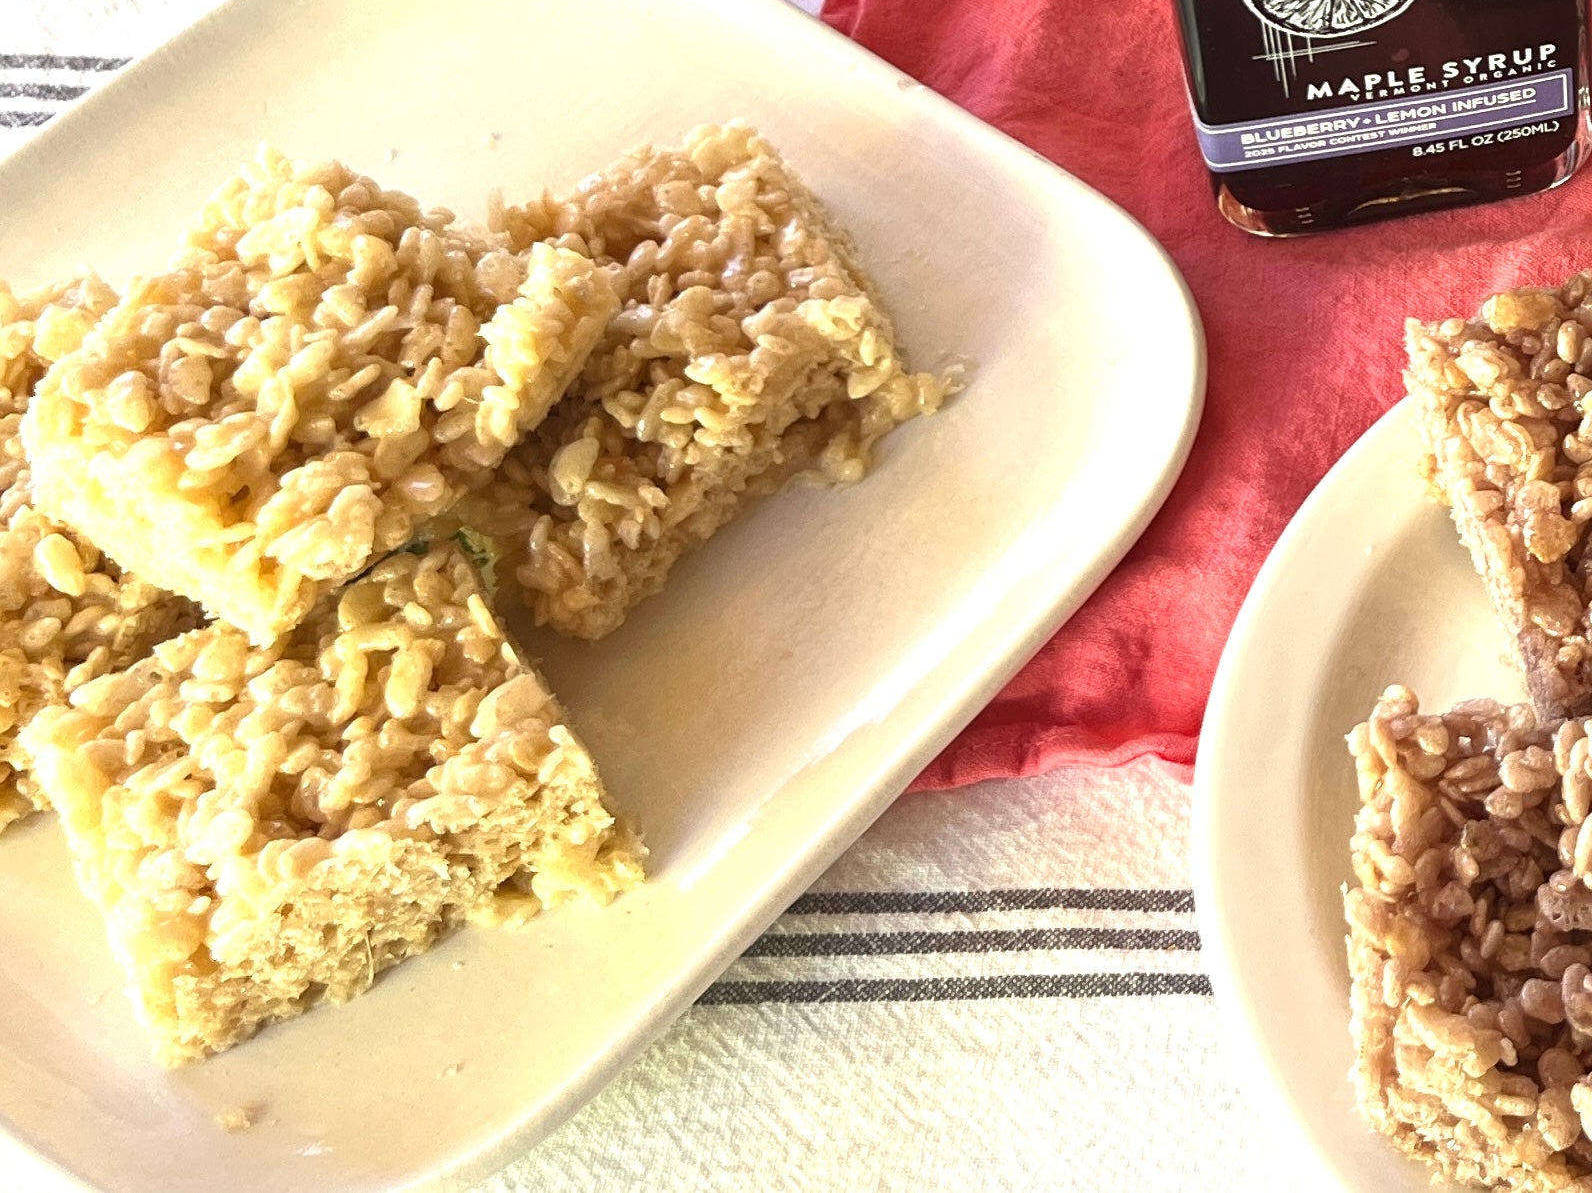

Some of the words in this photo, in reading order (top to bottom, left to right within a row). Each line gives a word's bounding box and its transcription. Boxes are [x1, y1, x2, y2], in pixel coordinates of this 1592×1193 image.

[1306, 66, 1426, 100] MAPLE
[1442, 44, 1557, 78] SYRUP
[1350, 79, 1450, 102] VERMONT
[1463, 59, 1557, 84] ORGANIC
[1240, 116, 1361, 145] BLUEBERRY
[1375, 103, 1446, 125] LEMON
[1452, 87, 1537, 112] INFUSED
[1279, 140, 1327, 153] FLAVOR
[1329, 130, 1387, 146] CONTEST
[1388, 122, 1437, 136] WINNER
[1412, 142, 1445, 157] 8.45
[1449, 136, 1469, 150] FL
[1471, 132, 1495, 146] OZ
[1496, 120, 1560, 143] (250ML)
